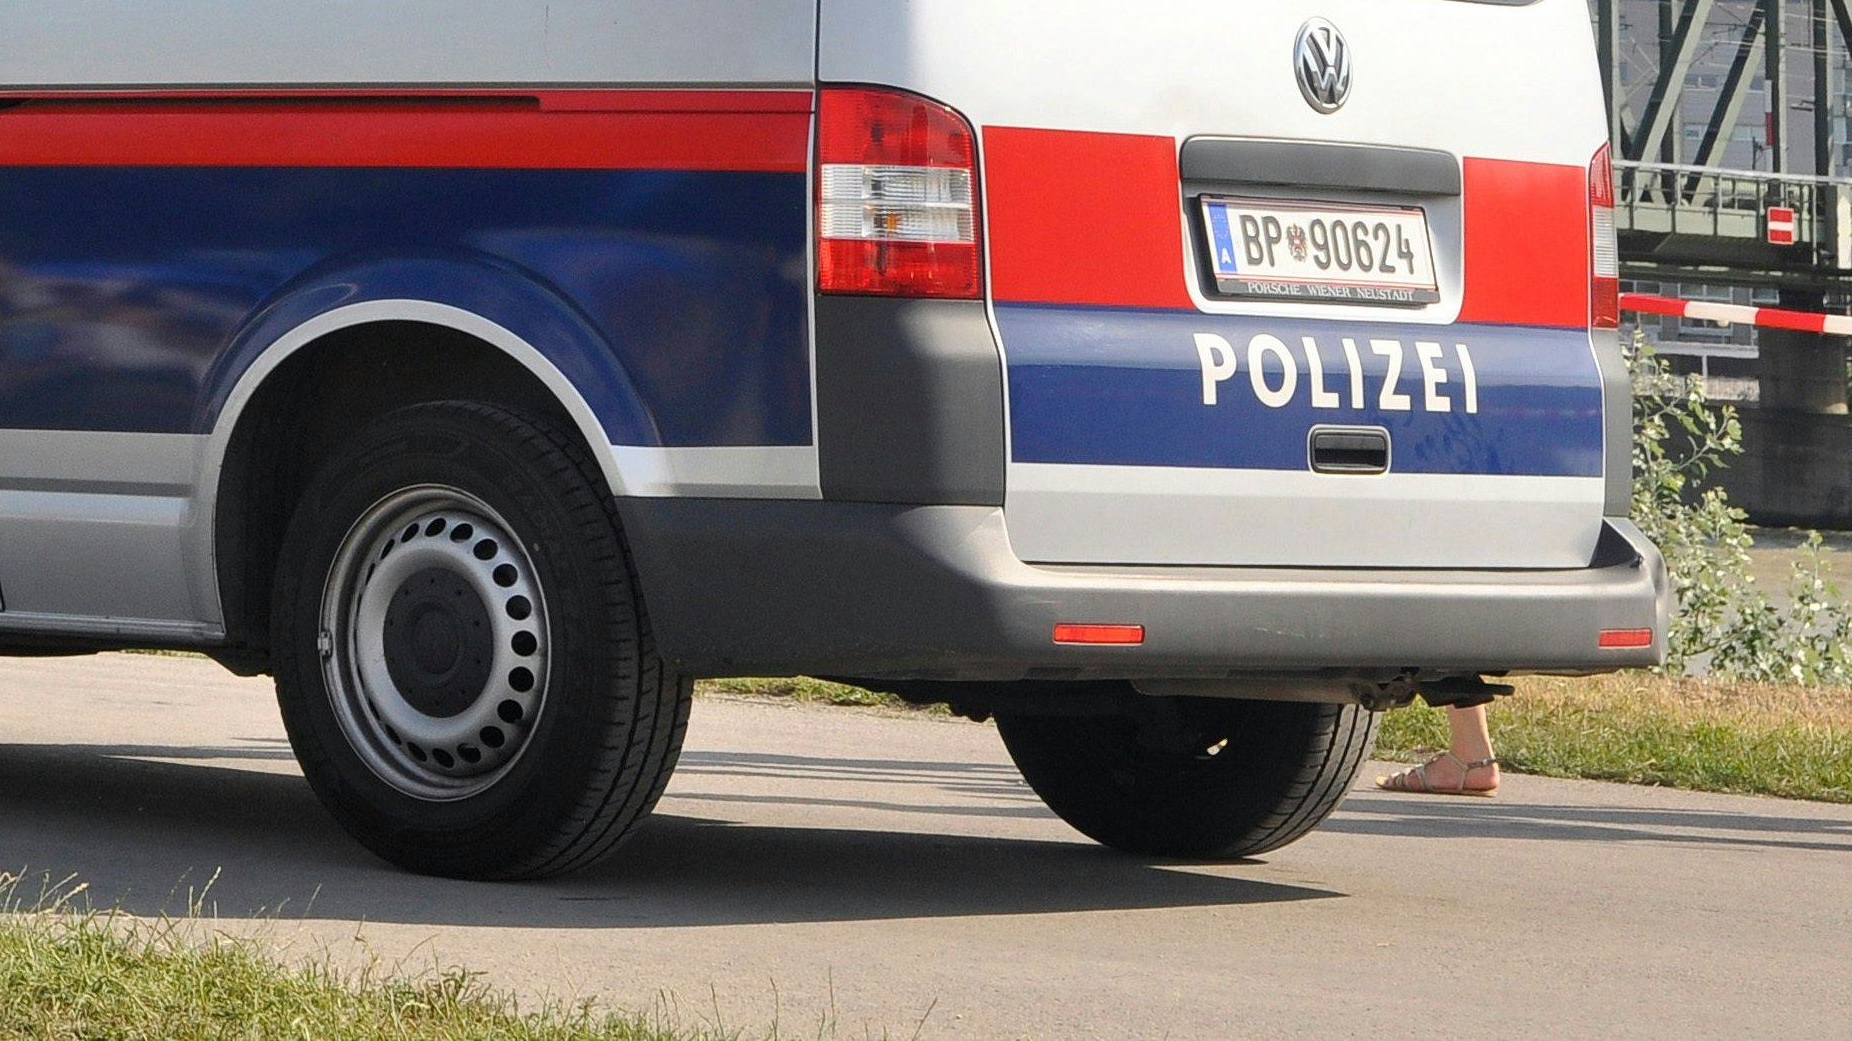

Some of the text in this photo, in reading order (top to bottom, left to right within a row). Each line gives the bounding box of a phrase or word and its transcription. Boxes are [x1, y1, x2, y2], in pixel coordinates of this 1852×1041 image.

[1220, 247, 1232, 264] A
[1239, 214, 1414, 275] BP 90624
[1248, 282, 1414, 302] PORSCHE WIENER NEUSTADT
[1193, 333, 1478, 413] POLIZEI
